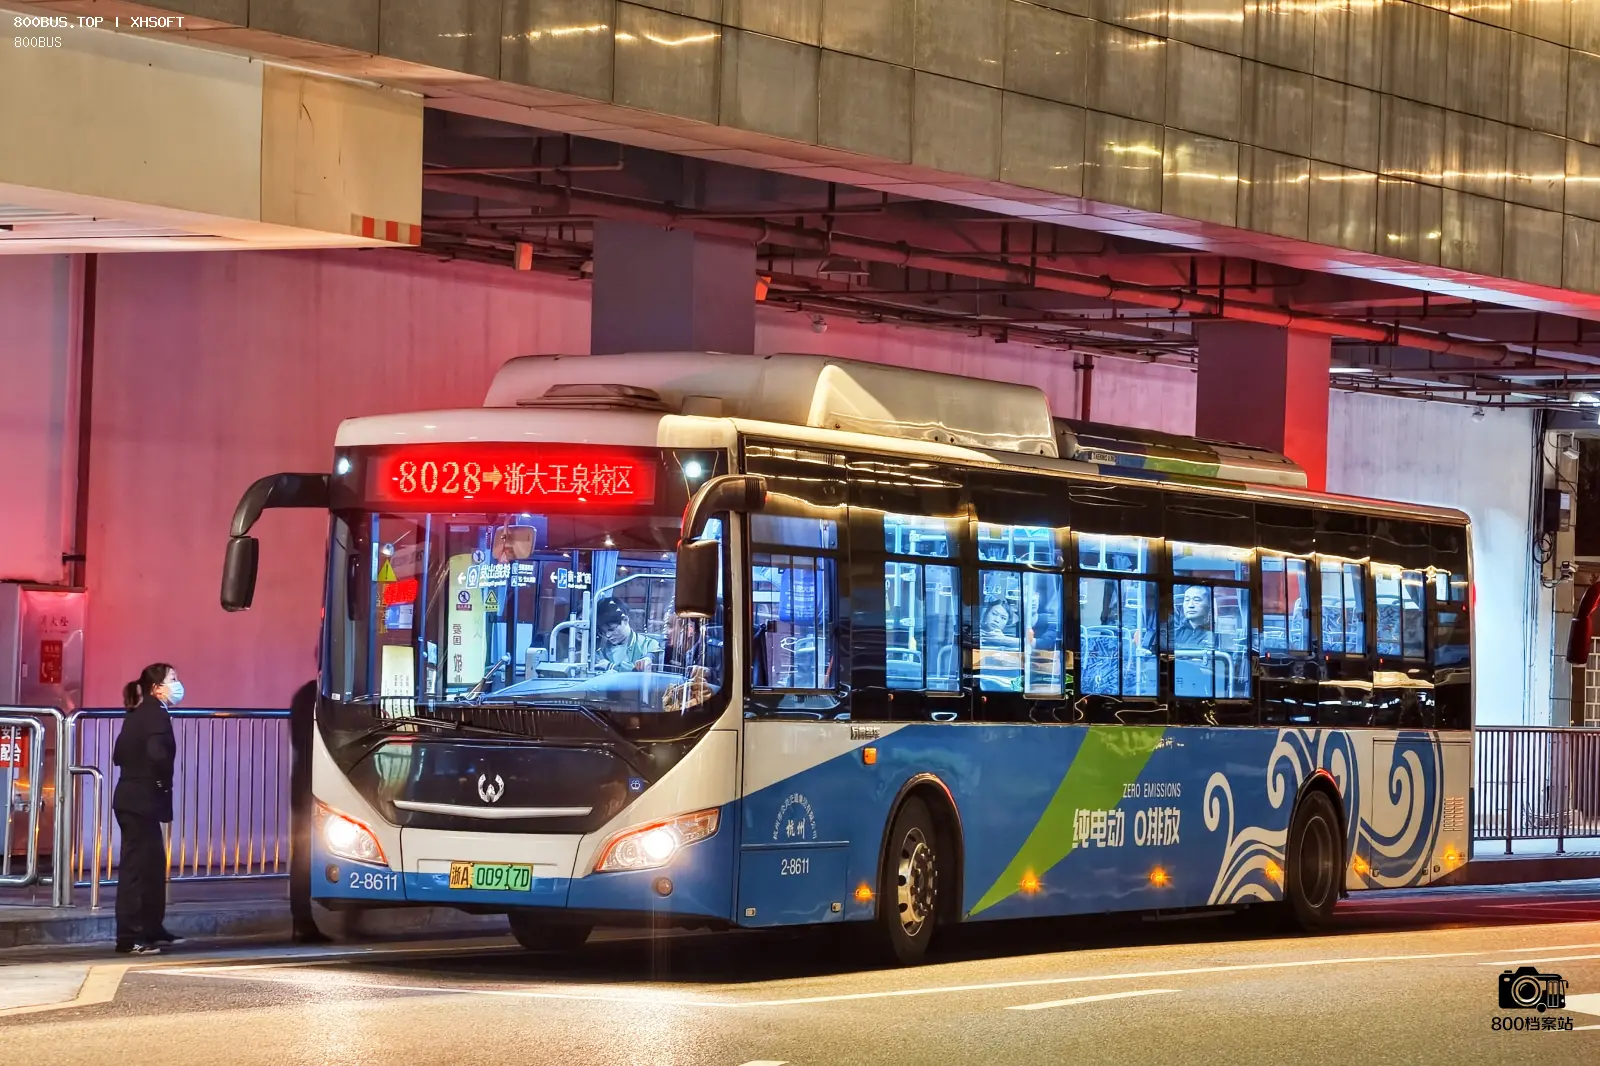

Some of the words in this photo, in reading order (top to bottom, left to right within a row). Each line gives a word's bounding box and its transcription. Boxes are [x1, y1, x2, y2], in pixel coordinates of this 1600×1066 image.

[399, 461, 481, 493] 8028
[503, 462, 634, 496] 浙大玉泉校区
[1123, 783, 1141, 798] ZERO
[1144, 783, 1182, 798] EMISSIONS
[786, 817, 805, 839] 杭州
[1071, 808, 1125, 849] 纯电动
[451, 866, 469, 886] 浙A
[476, 867, 530, 887] 00917D
[780, 857, 809, 875] 2-8611
[349, 871, 399, 892] 2-8611
